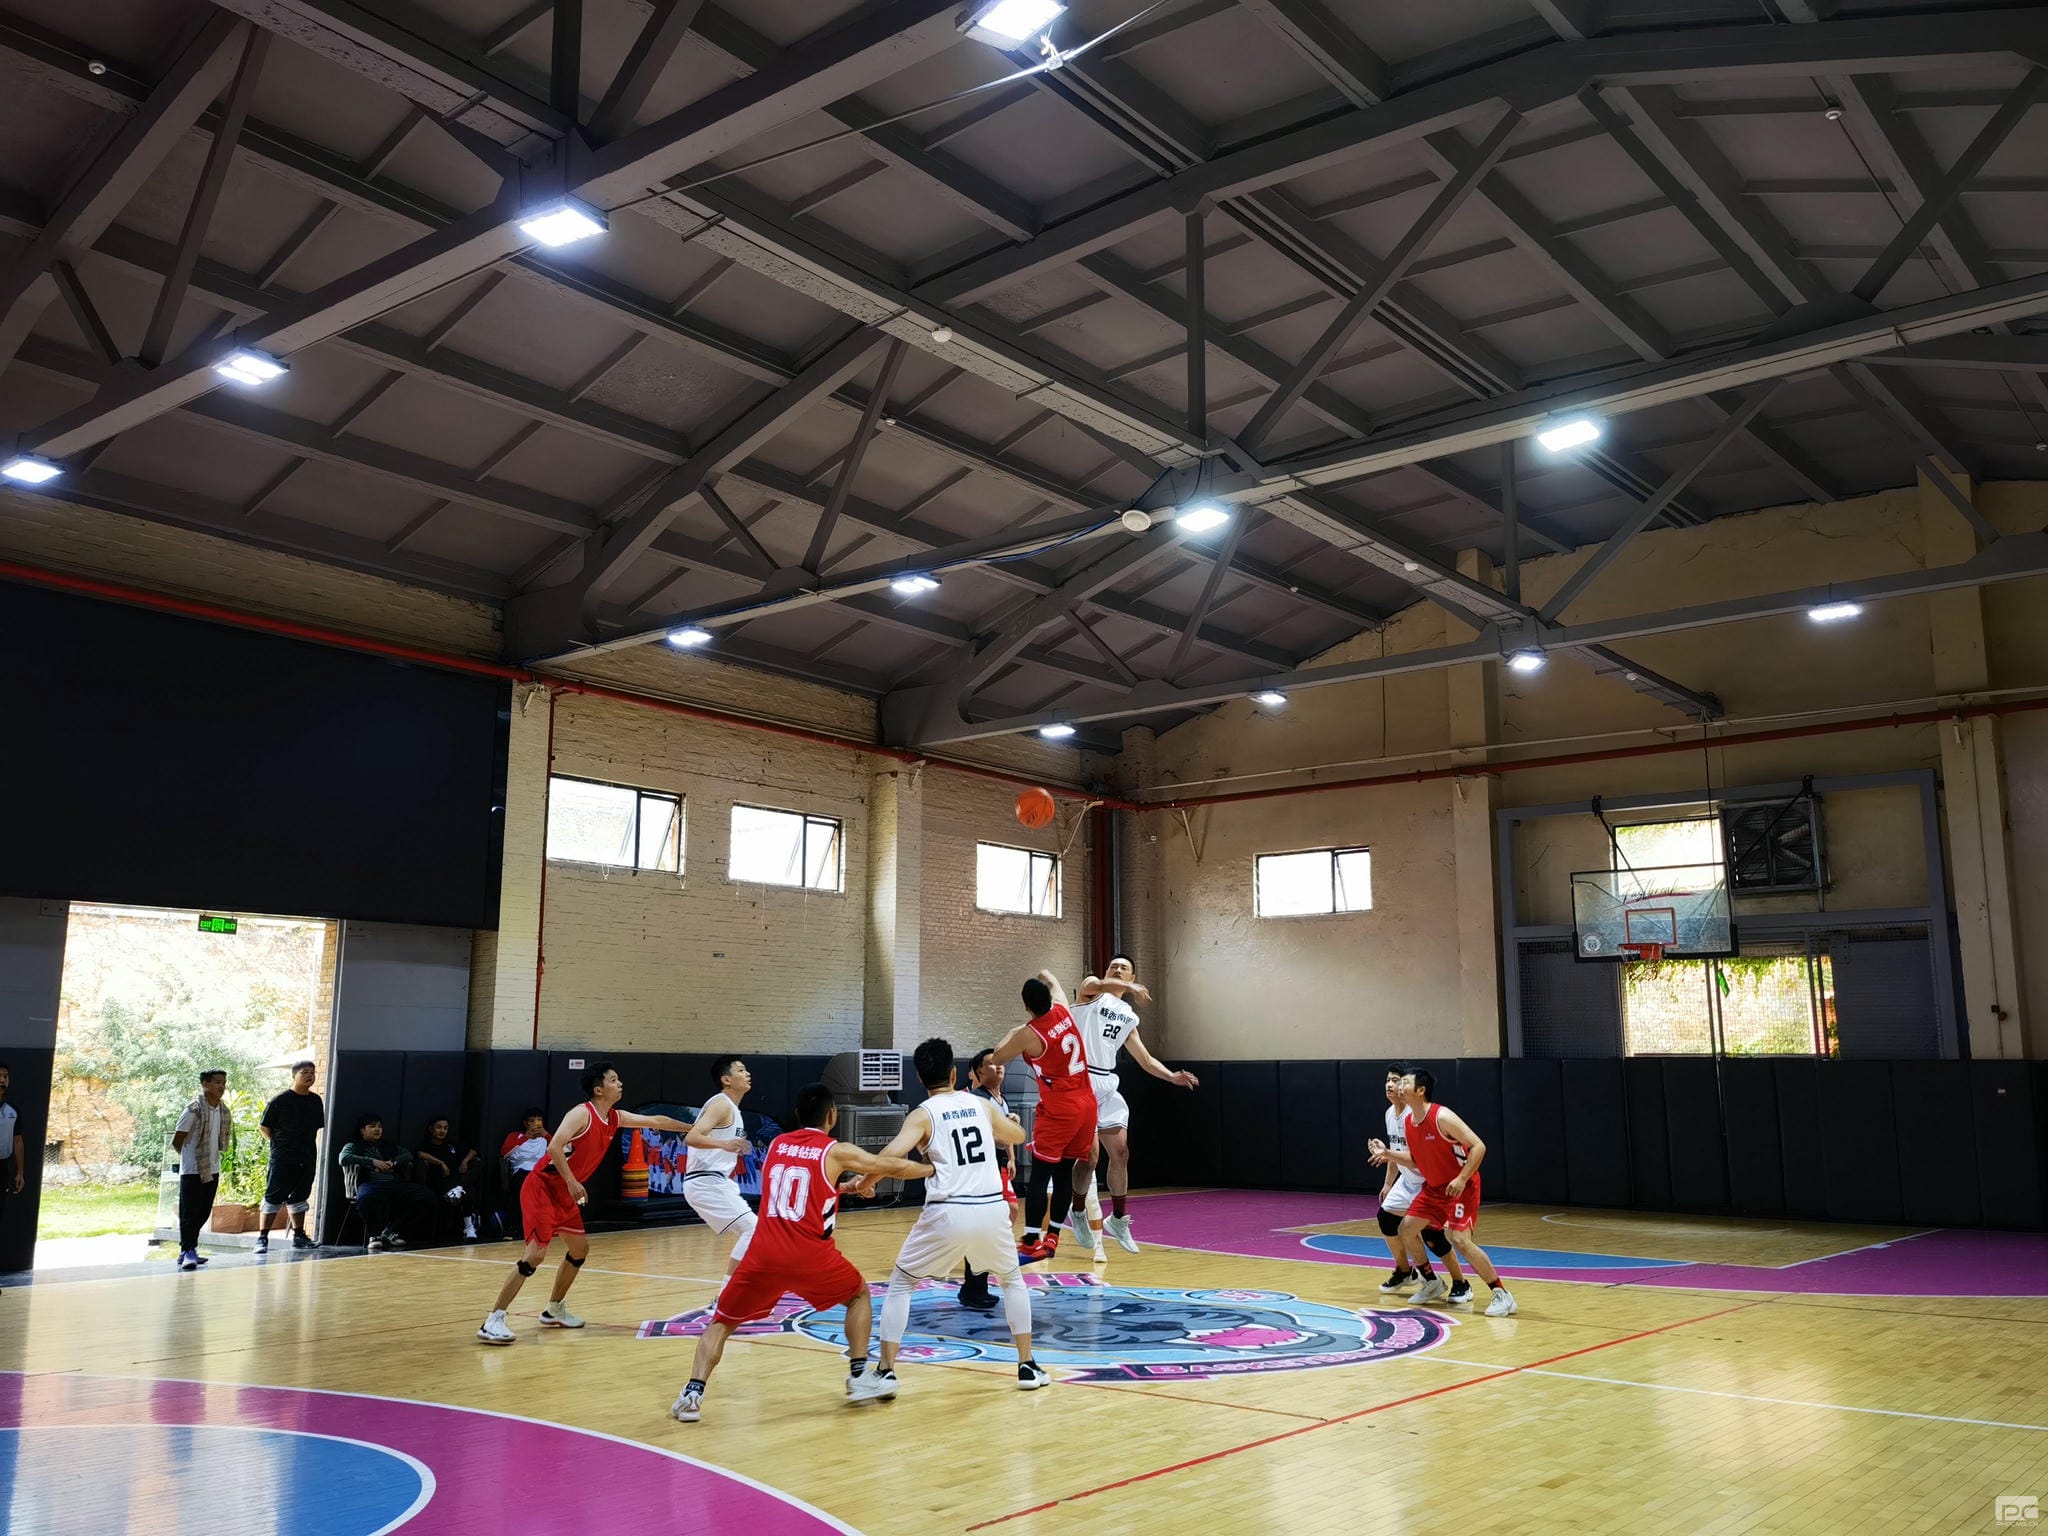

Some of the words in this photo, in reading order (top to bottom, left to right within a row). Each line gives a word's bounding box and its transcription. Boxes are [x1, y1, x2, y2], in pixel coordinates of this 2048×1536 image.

[1061, 1033, 1085, 1076] 2
[951, 1125, 986, 1166] 12
[767, 1163, 811, 1222] 10
[1454, 1203, 1465, 1219] 6
